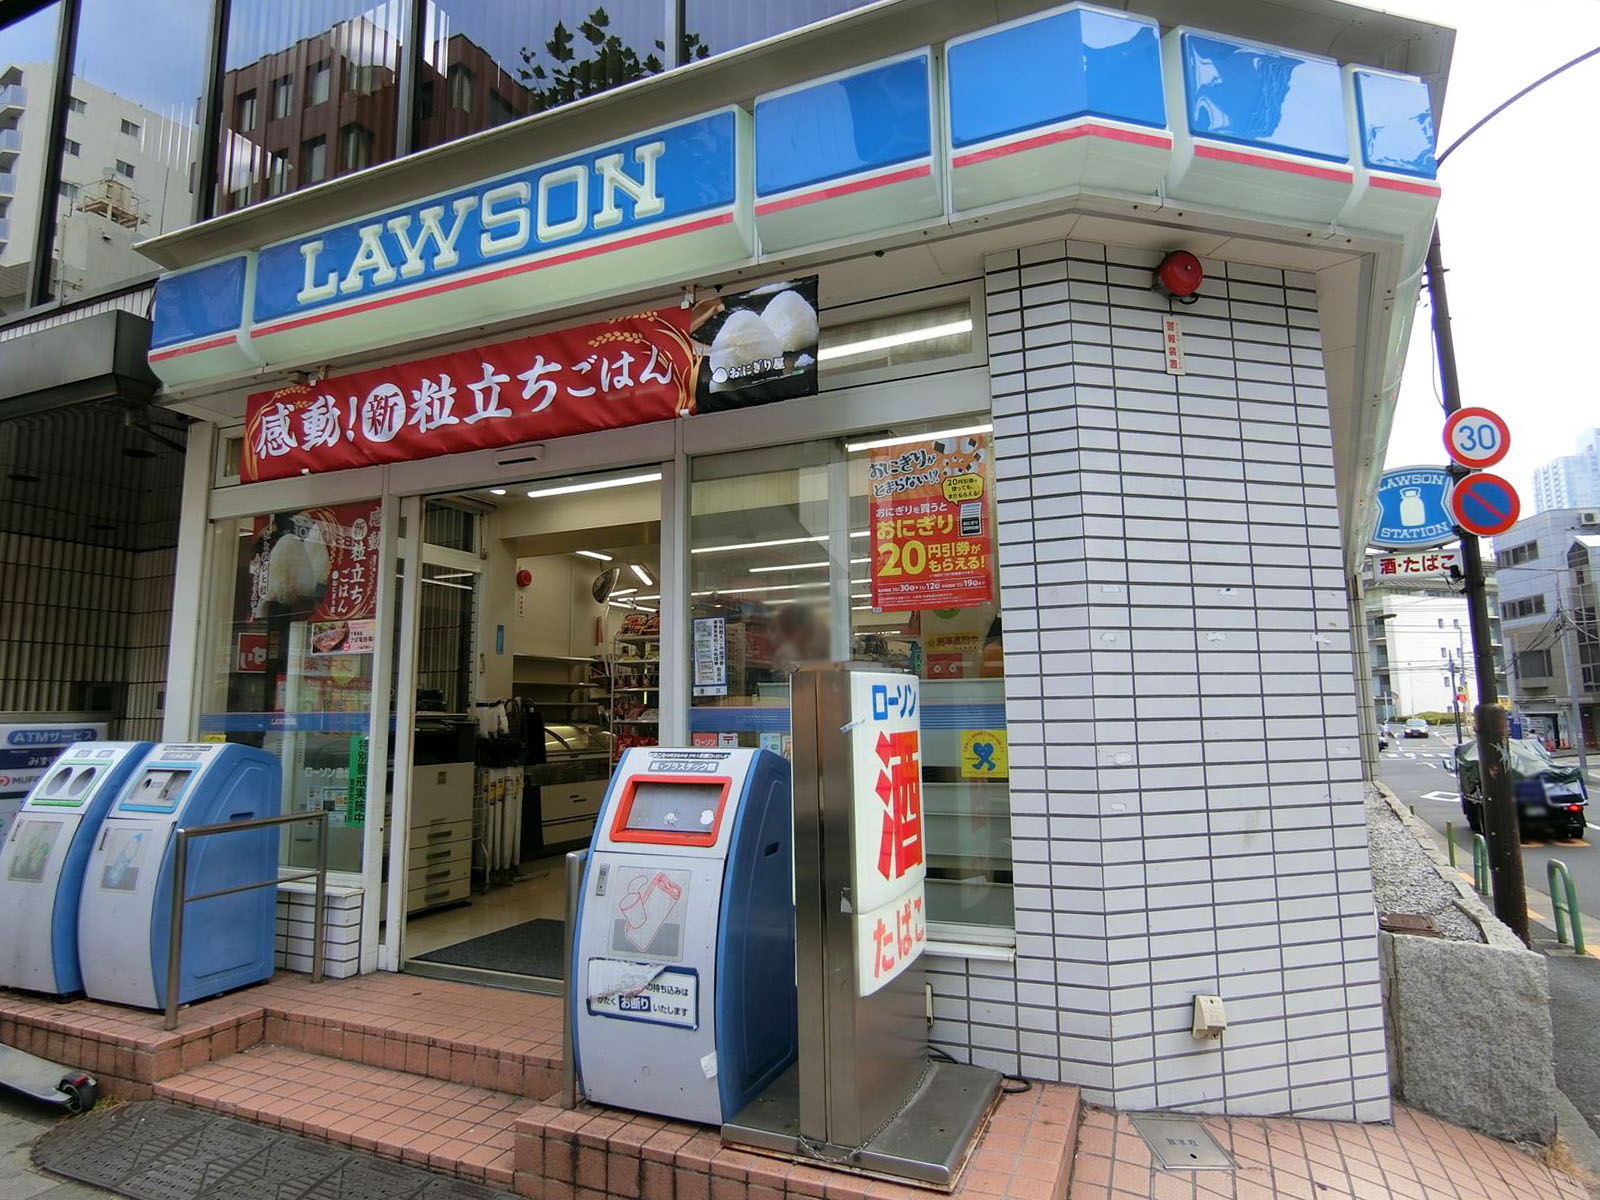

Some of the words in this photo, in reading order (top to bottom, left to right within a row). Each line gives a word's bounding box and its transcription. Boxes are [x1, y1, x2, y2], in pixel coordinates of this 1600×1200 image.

[297, 141, 666, 306] LAWSON
[729, 357, 786, 379] おにぎり屋
[1458, 424, 1496, 451] 30
[877, 513, 953, 540] おにぎり
[1380, 522, 1449, 539] STATION
[929, 556, 985, 573] もらえる!
[337, 567, 351, 613] ごはん
[869, 684, 917, 721] ローソン
[13, 731, 93, 743] ATMサービス
[695, 738, 716, 746] ローソン
[874, 730, 922, 881] 酒
[873, 899, 924, 979] たばこ
[653, 1004, 688, 1017] いたします
